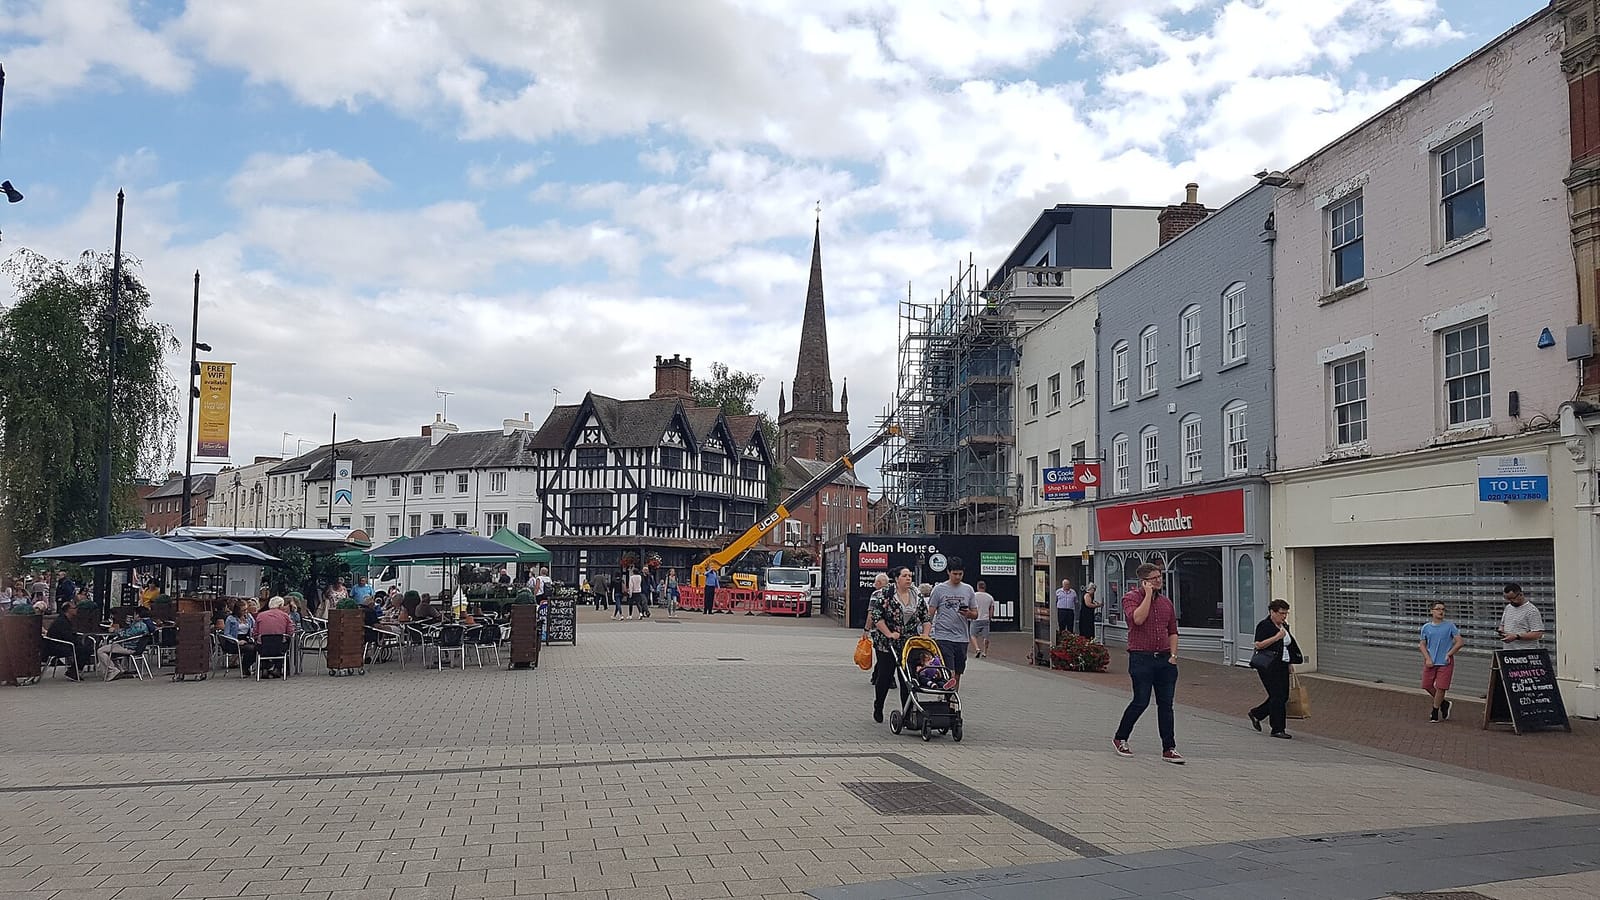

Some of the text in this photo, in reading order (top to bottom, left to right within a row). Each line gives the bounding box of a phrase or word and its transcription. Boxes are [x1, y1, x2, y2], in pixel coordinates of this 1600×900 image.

[1489, 480, 1537, 491] TO LET
[759, 512, 779, 531] JCB
[1142, 508, 1193, 533] Santander
[859, 541, 894, 553] Alban
[1508, 668, 1546, 678] UNLIMITED
